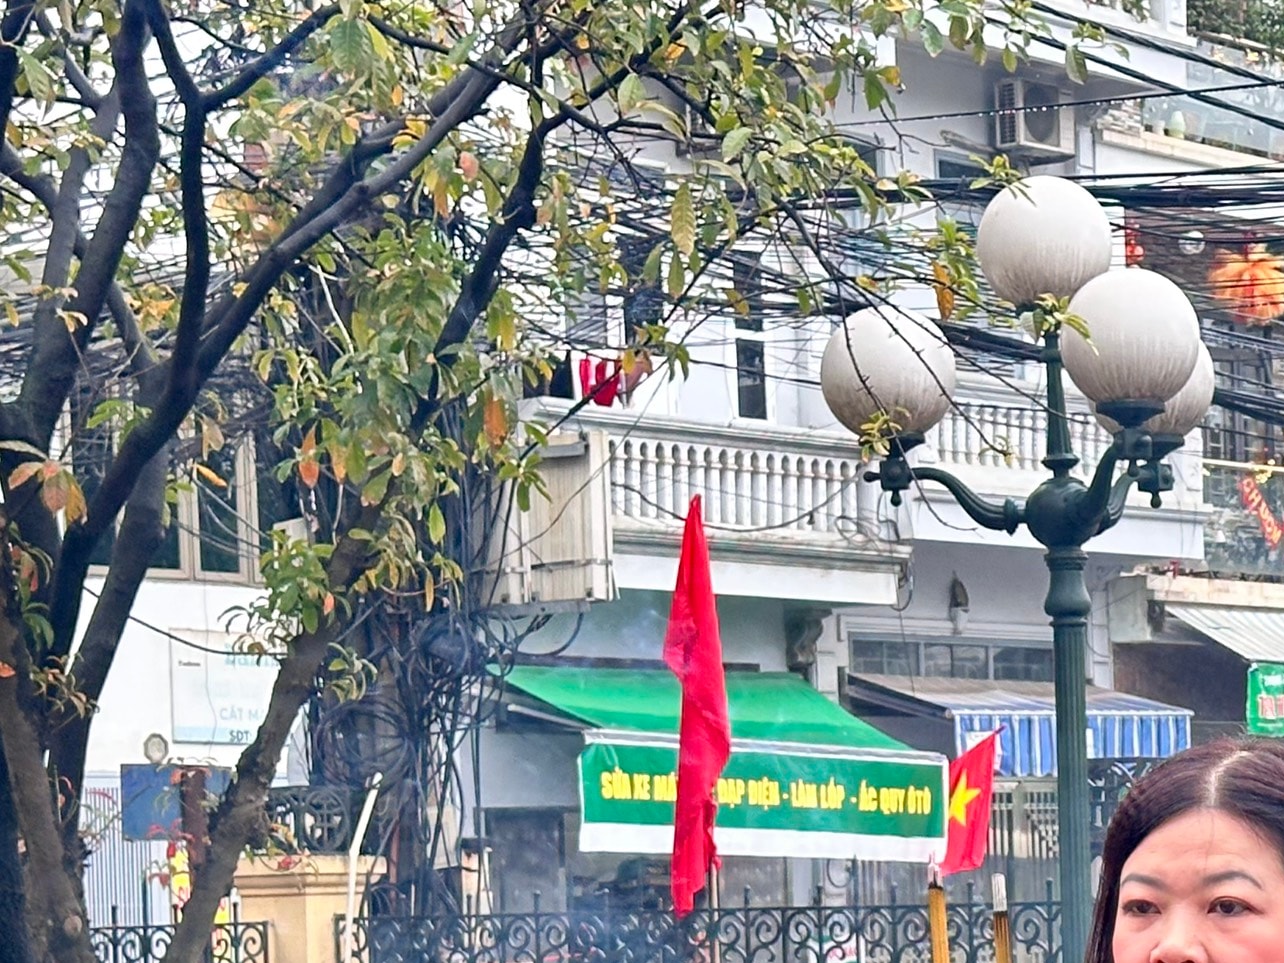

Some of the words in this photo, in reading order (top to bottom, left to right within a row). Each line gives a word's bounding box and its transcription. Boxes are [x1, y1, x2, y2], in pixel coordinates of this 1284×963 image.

[601, 766, 632, 800] SỬA
[633, 773, 651, 800] XE
[653, 772, 678, 802] MÁ
[879, 787, 906, 815] QUY
